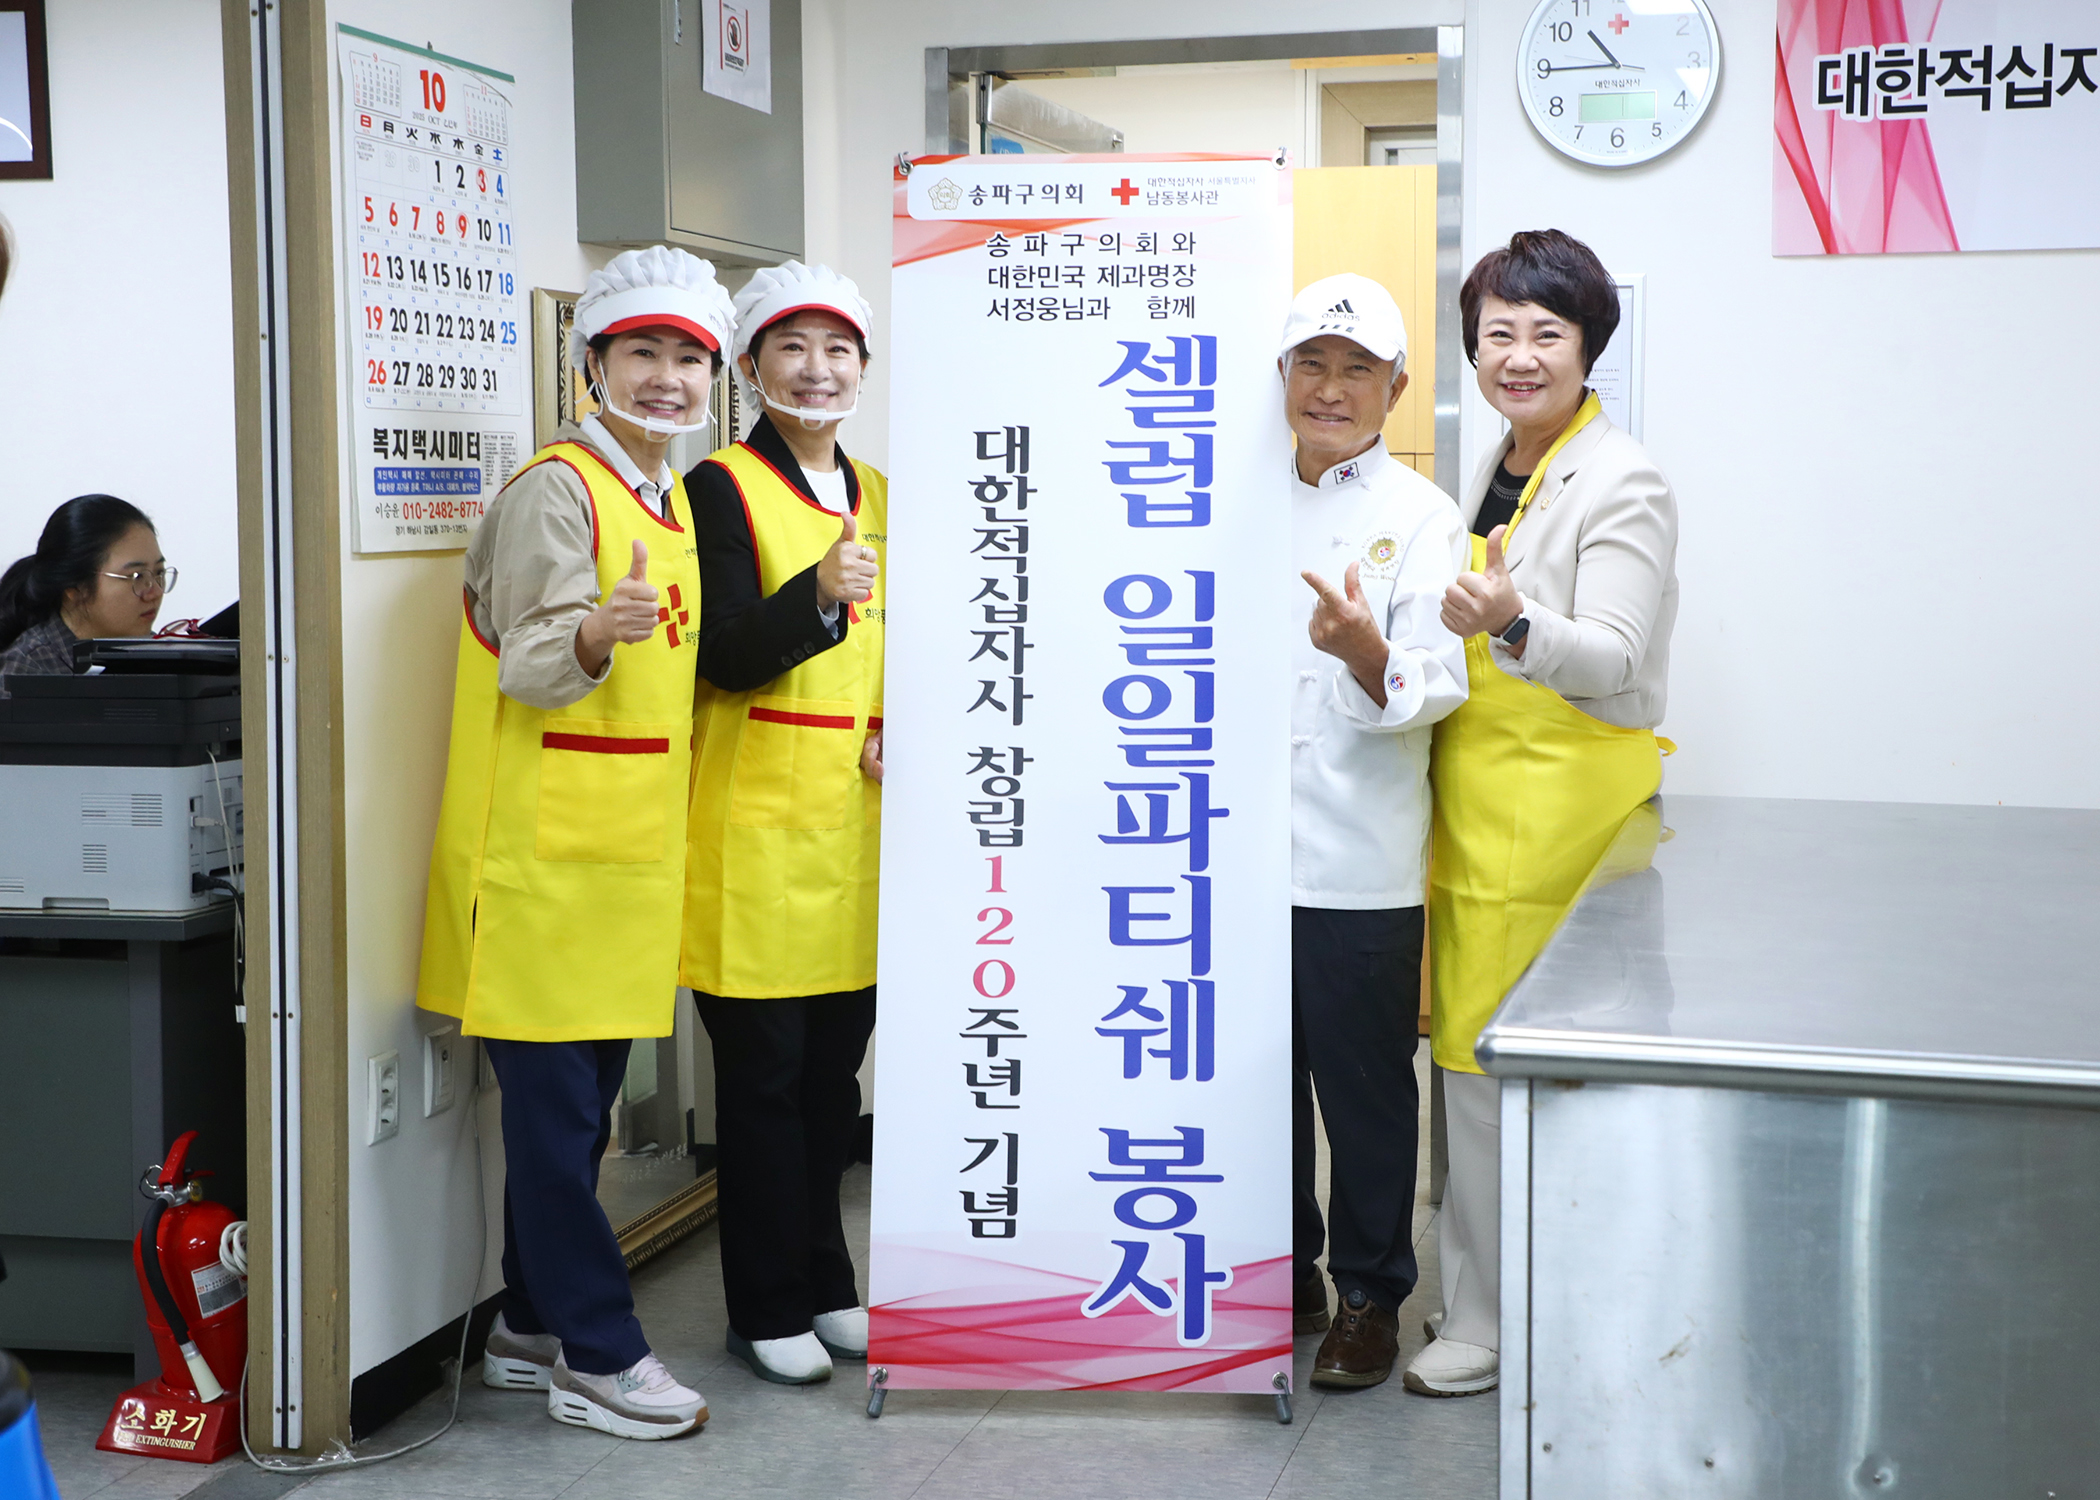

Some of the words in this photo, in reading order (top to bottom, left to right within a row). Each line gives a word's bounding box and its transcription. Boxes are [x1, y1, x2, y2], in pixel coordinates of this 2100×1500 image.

[1550, 22, 1573, 42] 10
[1676, 15, 1690, 36] 2
[1538, 58, 1551, 79] 9
[420, 70, 446, 113] 10
[1674, 90, 1688, 111] 4
[1549, 96, 1564, 117] 8
[1574, 125, 1584, 140] 7
[1611, 128, 1625, 148] 6
[1652, 123, 1662, 137] 5
[406, 127, 418, 140] 火
[430, 132, 442, 145] 水
[453, 138, 464, 150] 木
[475, 144, 484, 156] 金
[493, 149, 503, 161] 土
[435, 160, 441, 183] 1
[456, 164, 465, 189] 2
[478, 169, 486, 193] 3
[496, 174, 504, 198] 4
[1147, 177, 1204, 188] 대한적십자사
[968, 184, 1084, 206] 송파구의회
[1146, 190, 1219, 206] 남동봉사관
[365, 196, 374, 223] 5
[389, 202, 399, 227] 6
[412, 206, 420, 231] 7
[437, 211, 445, 235] 8
[458, 215, 467, 238] 9
[477, 219, 492, 242] 10
[498, 223, 512, 246] 11
[363, 252, 381, 278] 12
[387, 256, 404, 281] 13
[410, 259, 427, 284] 14
[433, 263, 451, 288] 15
[456, 267, 472, 291] 16
[477, 269, 493, 293] 17
[499, 273, 514, 296] 18
[987, 264, 1086, 289] 대한민국
[1097, 264, 1197, 288] 제과명장
[987, 297, 1111, 321] 서정웅님과
[1147, 296, 1196, 319] 함께
[1322, 312, 1360, 322] adidas
[365, 306, 383, 330] 19
[390, 308, 408, 333] 20
[415, 310, 430, 335] 21
[436, 314, 454, 338] 22
[458, 316, 475, 341] 23
[480, 319, 495, 342] 24
[501, 321, 517, 345] 25
[368, 359, 387, 385] 26
[392, 361, 410, 386] 27
[417, 363, 434, 388] 28
[439, 364, 455, 389] 29
[460, 367, 477, 390] 30
[483, 368, 497, 392] 31
[1099, 334, 1217, 528] 셀럽
[373, 428, 481, 461] 복지택시미터
[403, 501, 484, 520] 010-2482-8774
[966, 426, 1038, 725] 대한적십자사
[1096, 570, 1231, 1082] 일일파티쉐
[959, 1132, 1019, 1239] 기념
[1088, 1126, 1228, 1341] 봉사
[121, 1407, 207, 1441] 소화기
[136, 1434, 196, 1451] EXTINGUISHER
